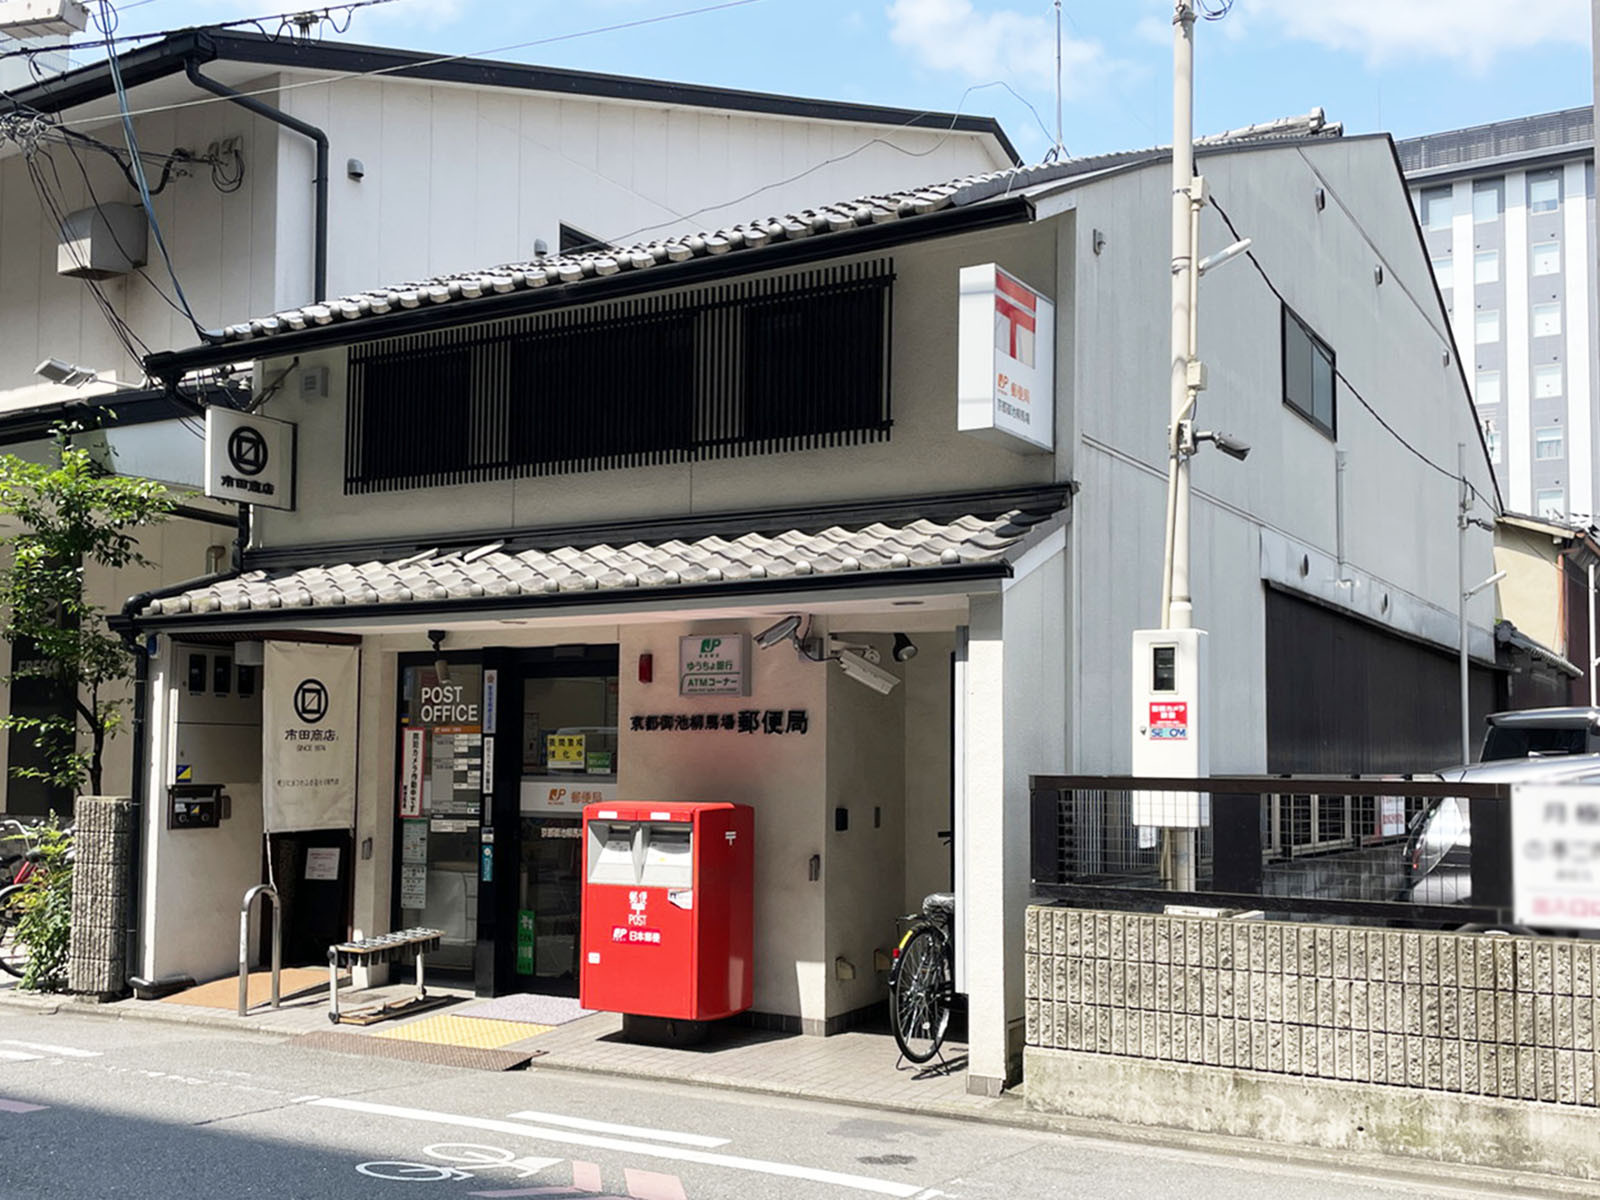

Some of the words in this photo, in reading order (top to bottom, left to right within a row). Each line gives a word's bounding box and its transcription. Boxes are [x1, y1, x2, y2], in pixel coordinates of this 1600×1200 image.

[221, 475, 275, 496] 市田商店
[686, 660, 733, 671] ゆうちょ銀行
[687, 677, 737, 687] ATMコーナー
[421, 686, 464, 704] POST
[420, 704, 479, 722] OFFICE
[630, 709, 808, 735] 京都御池柳馬場郵便局
[284, 728, 337, 742] 市田商店
[571, 791, 602, 804] 郵便局
[628, 914, 647, 926] POST
[629, 931, 660, 943] 日本郵便
